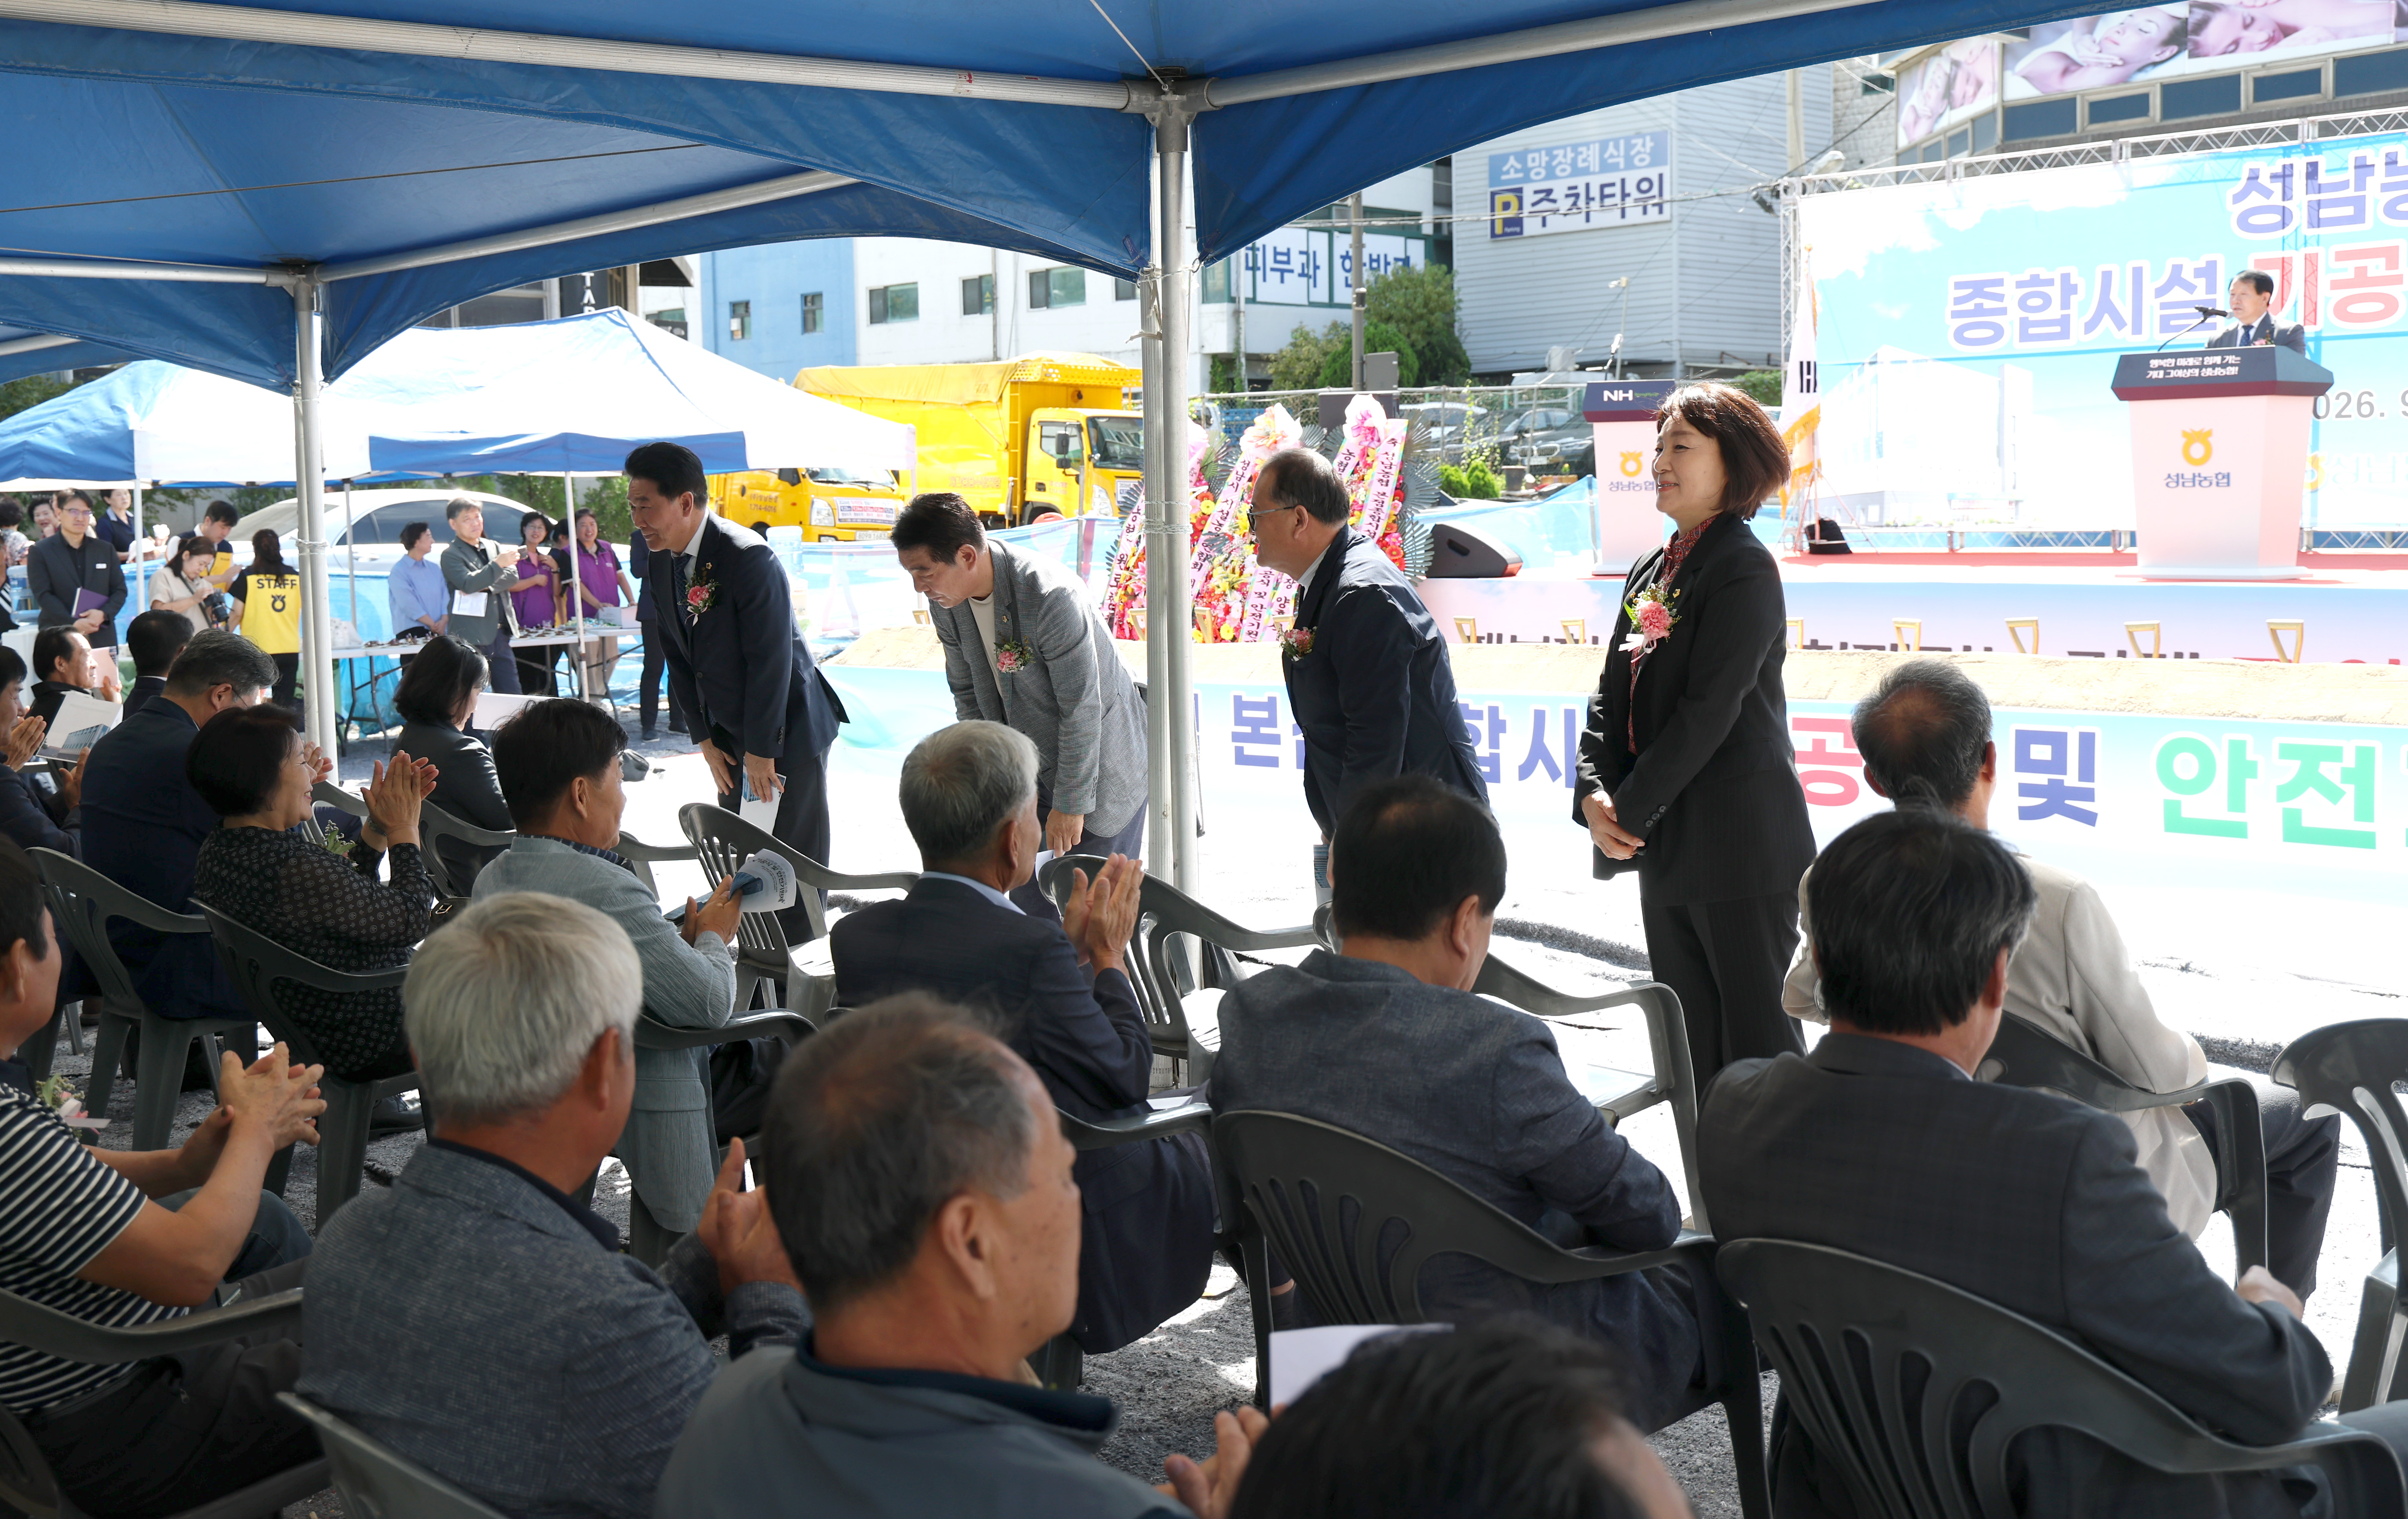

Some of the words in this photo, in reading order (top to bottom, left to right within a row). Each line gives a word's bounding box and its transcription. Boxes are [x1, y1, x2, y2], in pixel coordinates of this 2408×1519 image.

[1501, 135, 1654, 181] 소망장례식장
[1529, 173, 1664, 228] 주차타워
[1245, 244, 1320, 288] 피부과
[1951, 260, 2217, 346] 종합시설
[1603, 390, 1634, 401] NH
[2313, 391, 2385, 419] 026.
[1228, 460, 1251, 493] 성남시
[1337, 449, 1356, 475] 농협
[1376, 451, 1397, 487] 성남농협
[2329, 455, 2408, 484] 성남
[1608, 481, 1655, 492] 성남농협
[2164, 472, 2230, 488] 성남농협
[257, 578, 297, 589] STAFF
[1256, 570, 1275, 587] 공식
[1245, 603, 1266, 642] 안전기원
[2014, 729, 2098, 827] 및
[2156, 737, 2408, 850] 안전
[753, 858, 773, 866] 기공식
[776, 871, 785, 903] 안전기원제
